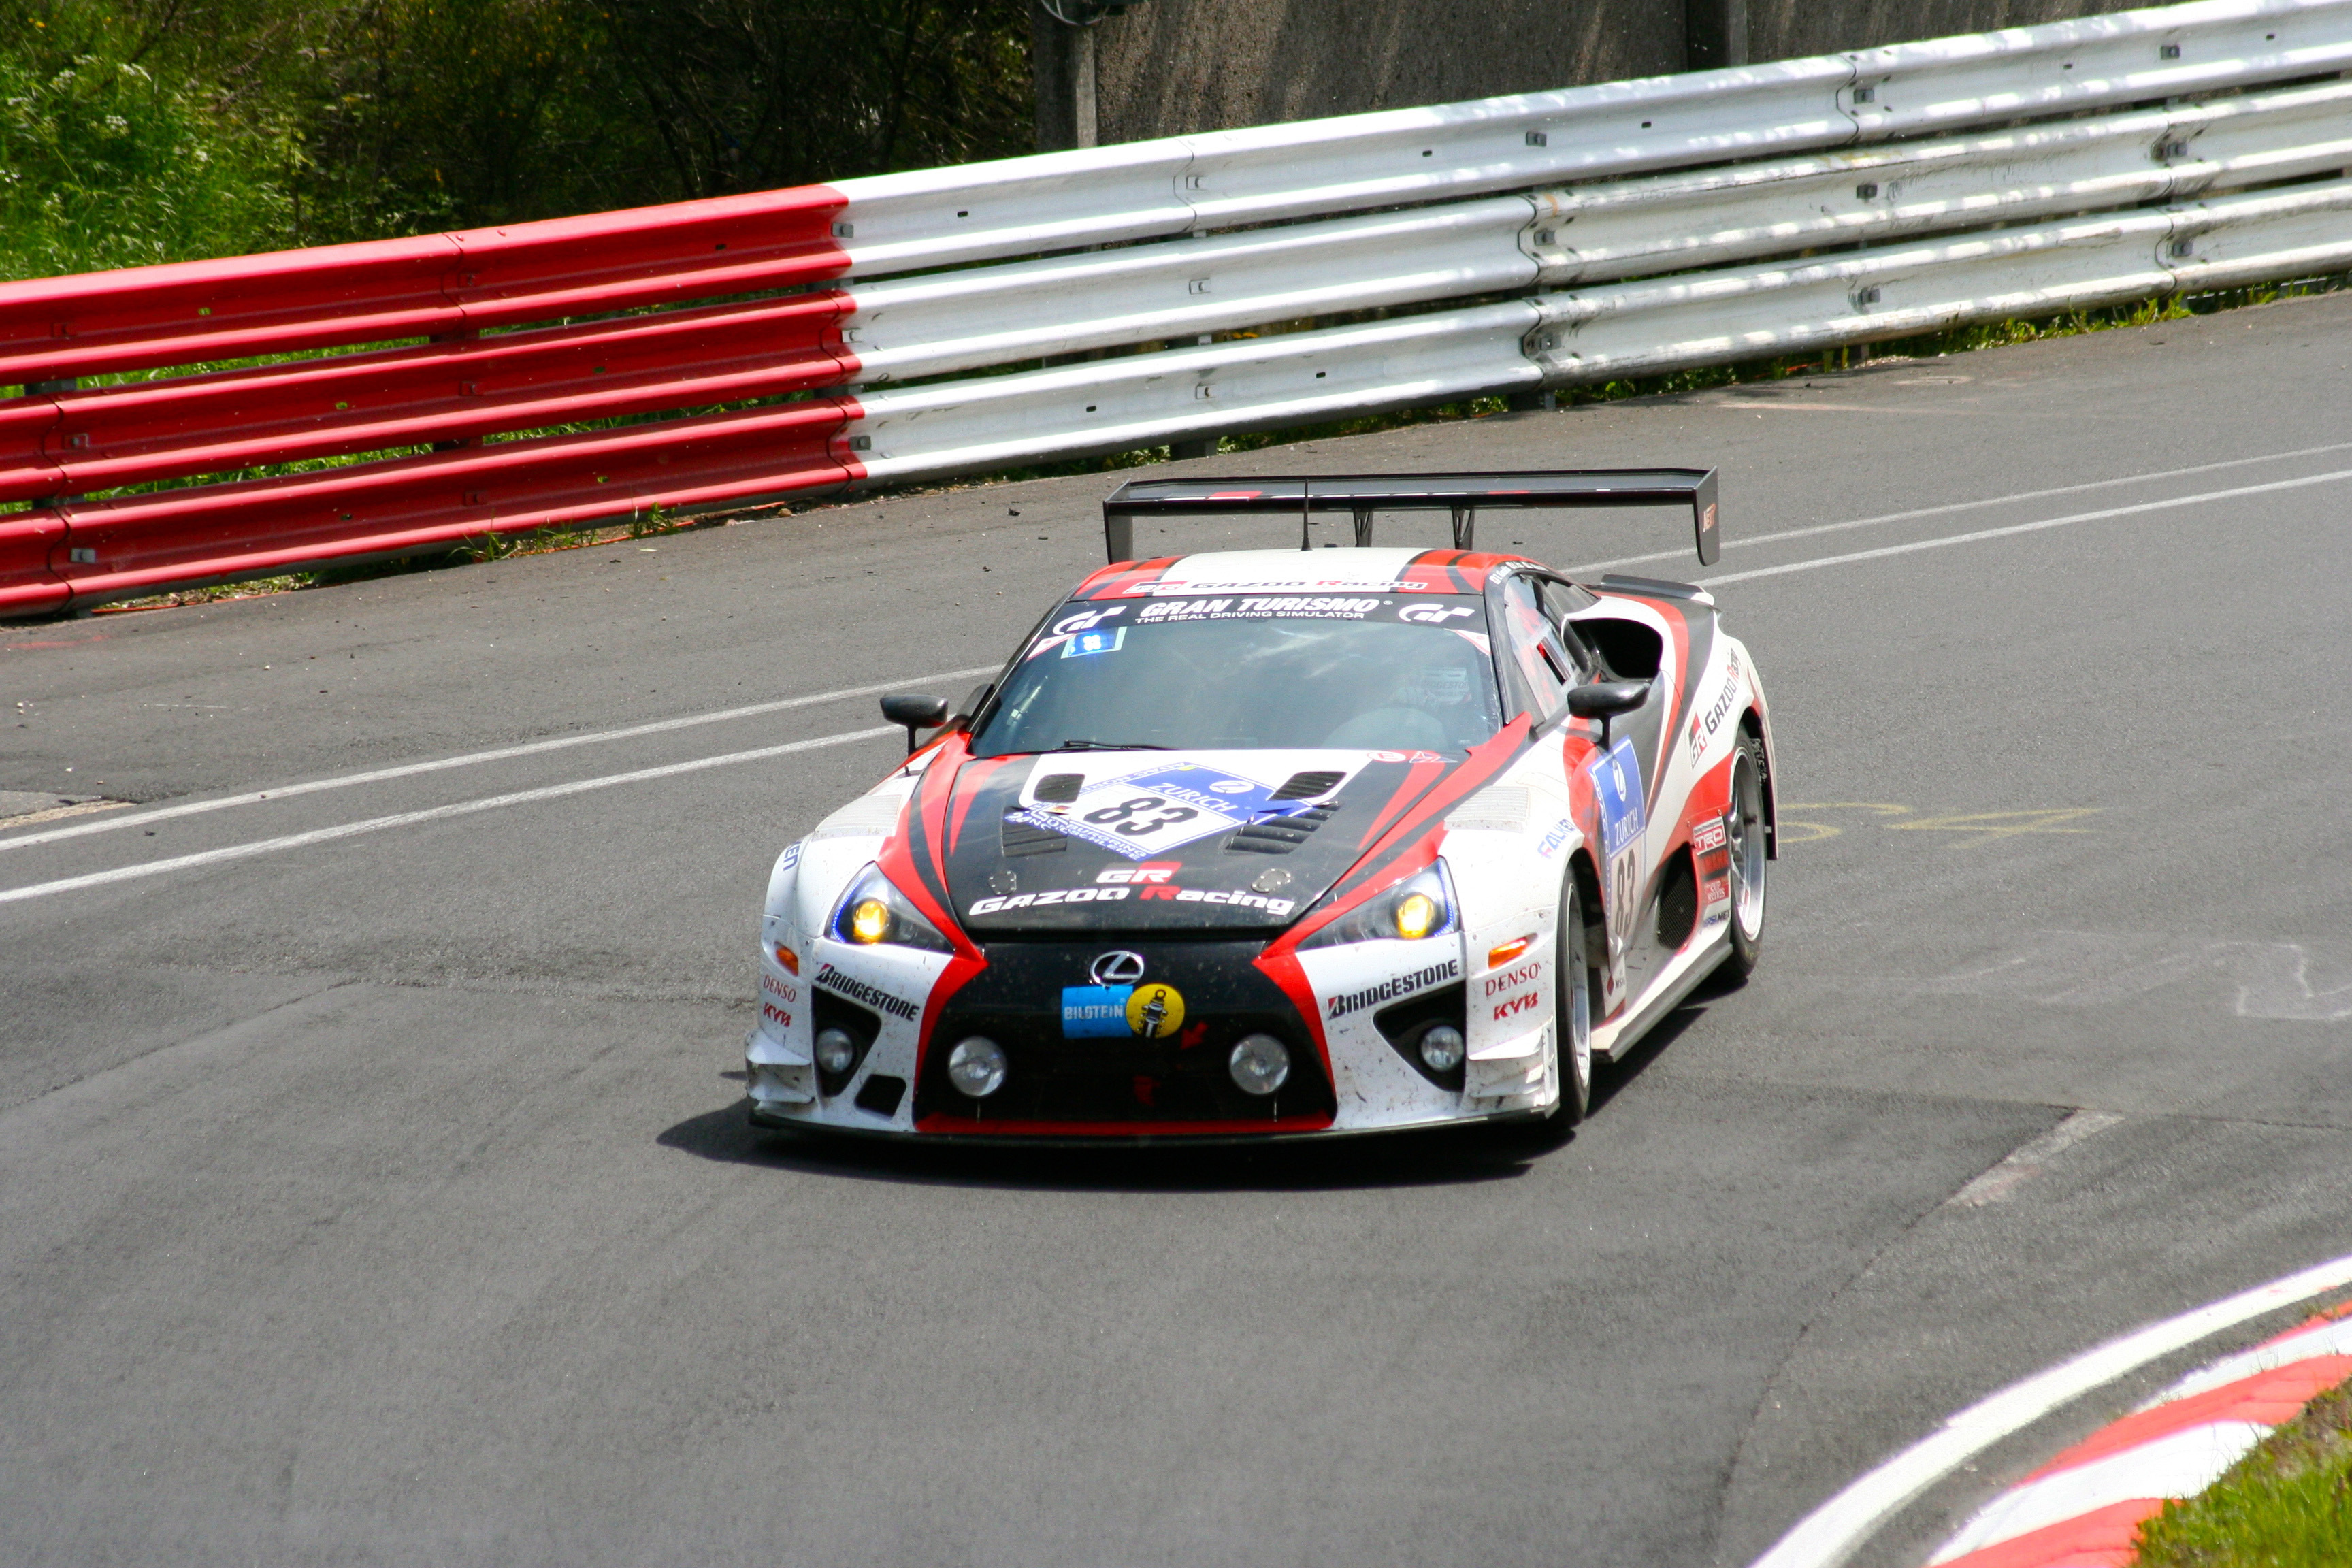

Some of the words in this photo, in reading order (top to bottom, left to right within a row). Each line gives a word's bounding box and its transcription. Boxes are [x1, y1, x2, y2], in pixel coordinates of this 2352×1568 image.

[1315, 580, 1428, 590] Racing
[1135, 616, 1164, 624] THE
[1167, 613, 1207, 622] REAL
[1210, 610, 1273, 619] DRIVING
[1279, 610, 1365, 619] SIMULATOR
[1140, 598, 1233, 617] GRAN
[1237, 597, 1381, 612] TURISMO
[1705, 677, 1737, 736] GAZOO
[1147, 783, 1239, 813] ZURICH
[1083, 797, 1199, 836] 83
[1614, 807, 1639, 846] ZURICH
[1096, 869, 1173, 883] GR
[968, 887, 1130, 916] GAZOO
[1139, 885, 1295, 916] Racing
[1615, 849, 1635, 938] 83
[763, 973, 796, 1003] DENSO
[815, 963, 920, 1022] BRIDGESTONE
[1328, 958, 1459, 1020] BRIDGESTONE
[1485, 962, 1539, 996] DENSO
[1064, 1004, 1123, 1020] BILSTEIN
[1493, 992, 1539, 1022] KYB
